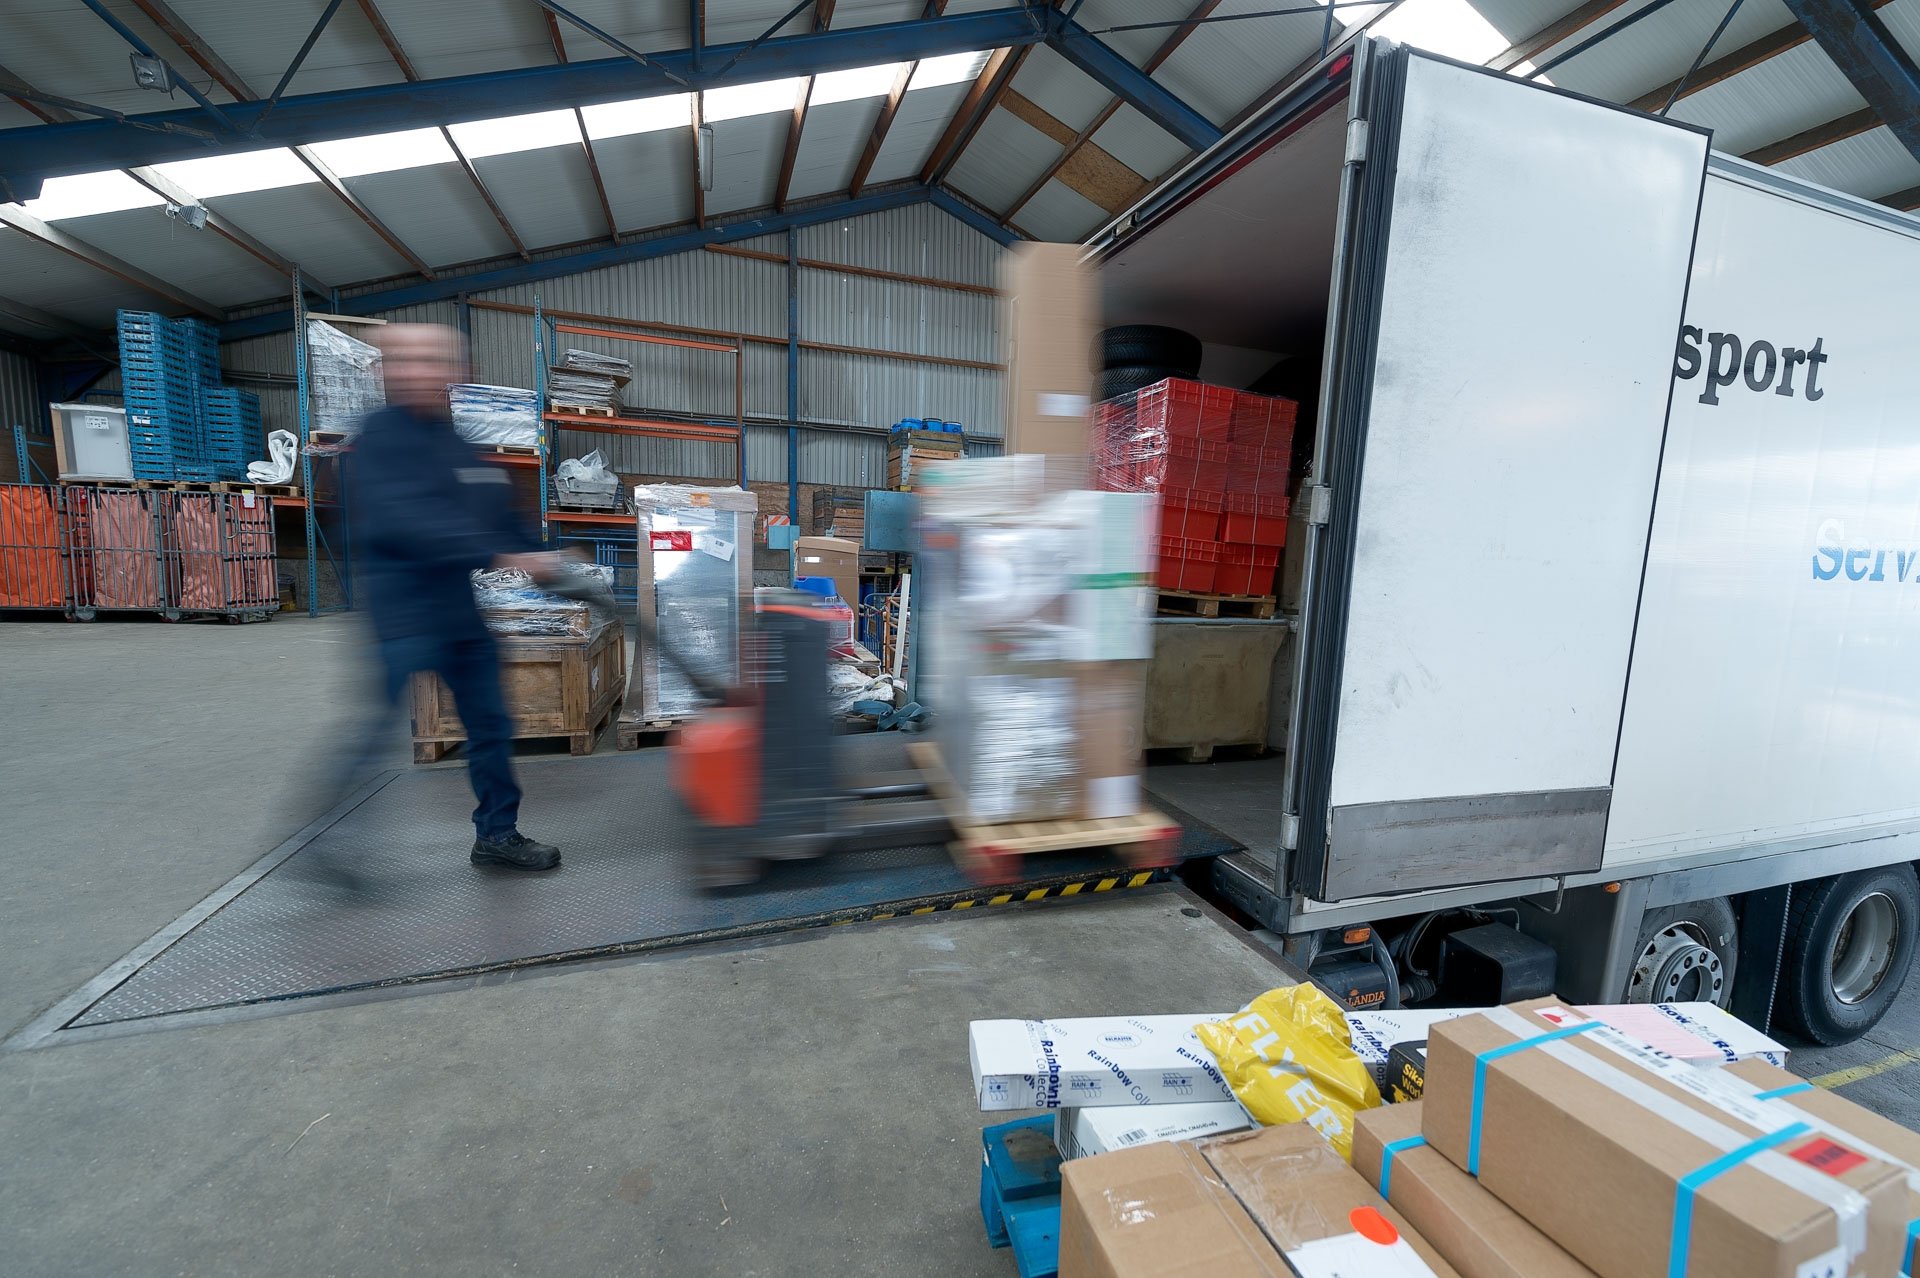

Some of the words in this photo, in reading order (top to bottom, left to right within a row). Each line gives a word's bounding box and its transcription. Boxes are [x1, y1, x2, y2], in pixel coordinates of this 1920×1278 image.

[1812, 518, 1920, 583] Serv
[1344, 991, 1386, 1007] LANDIA
[1087, 1049, 1133, 1087] Rainbow
[1176, 1047, 1223, 1085] Rainbow
[1233, 1012, 1344, 1141] FLYER
[1403, 1063, 1424, 1087] Sika
